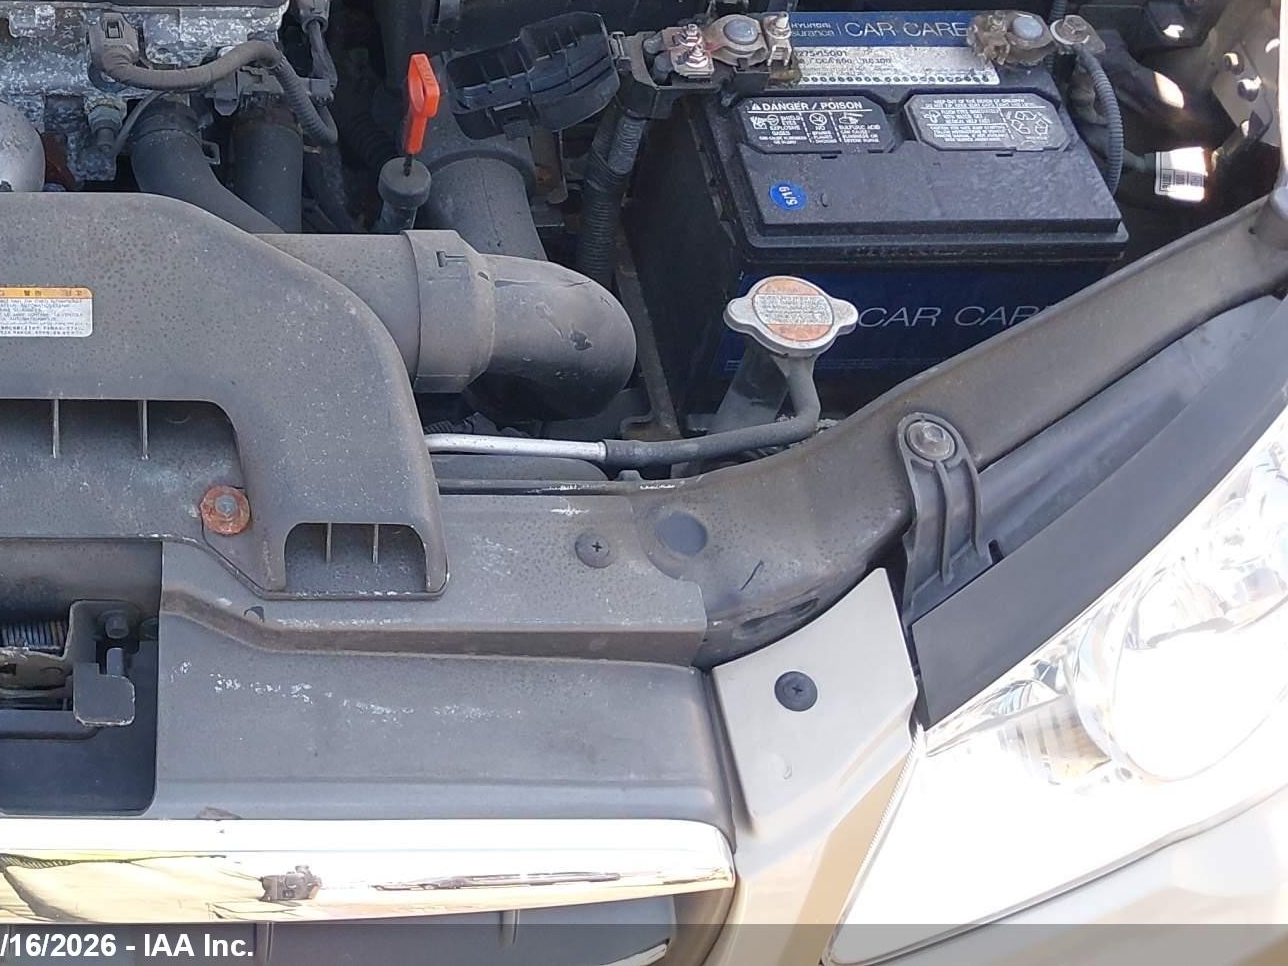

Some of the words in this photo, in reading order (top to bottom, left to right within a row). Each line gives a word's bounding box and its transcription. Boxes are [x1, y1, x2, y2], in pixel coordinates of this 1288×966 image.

[844, 22, 897, 37] CAR
[903, 22, 969, 37] CARE
[762, 102, 809, 110] DANGER
[820, 101, 863, 109] POISON
[858, 306, 941, 327] CAR
